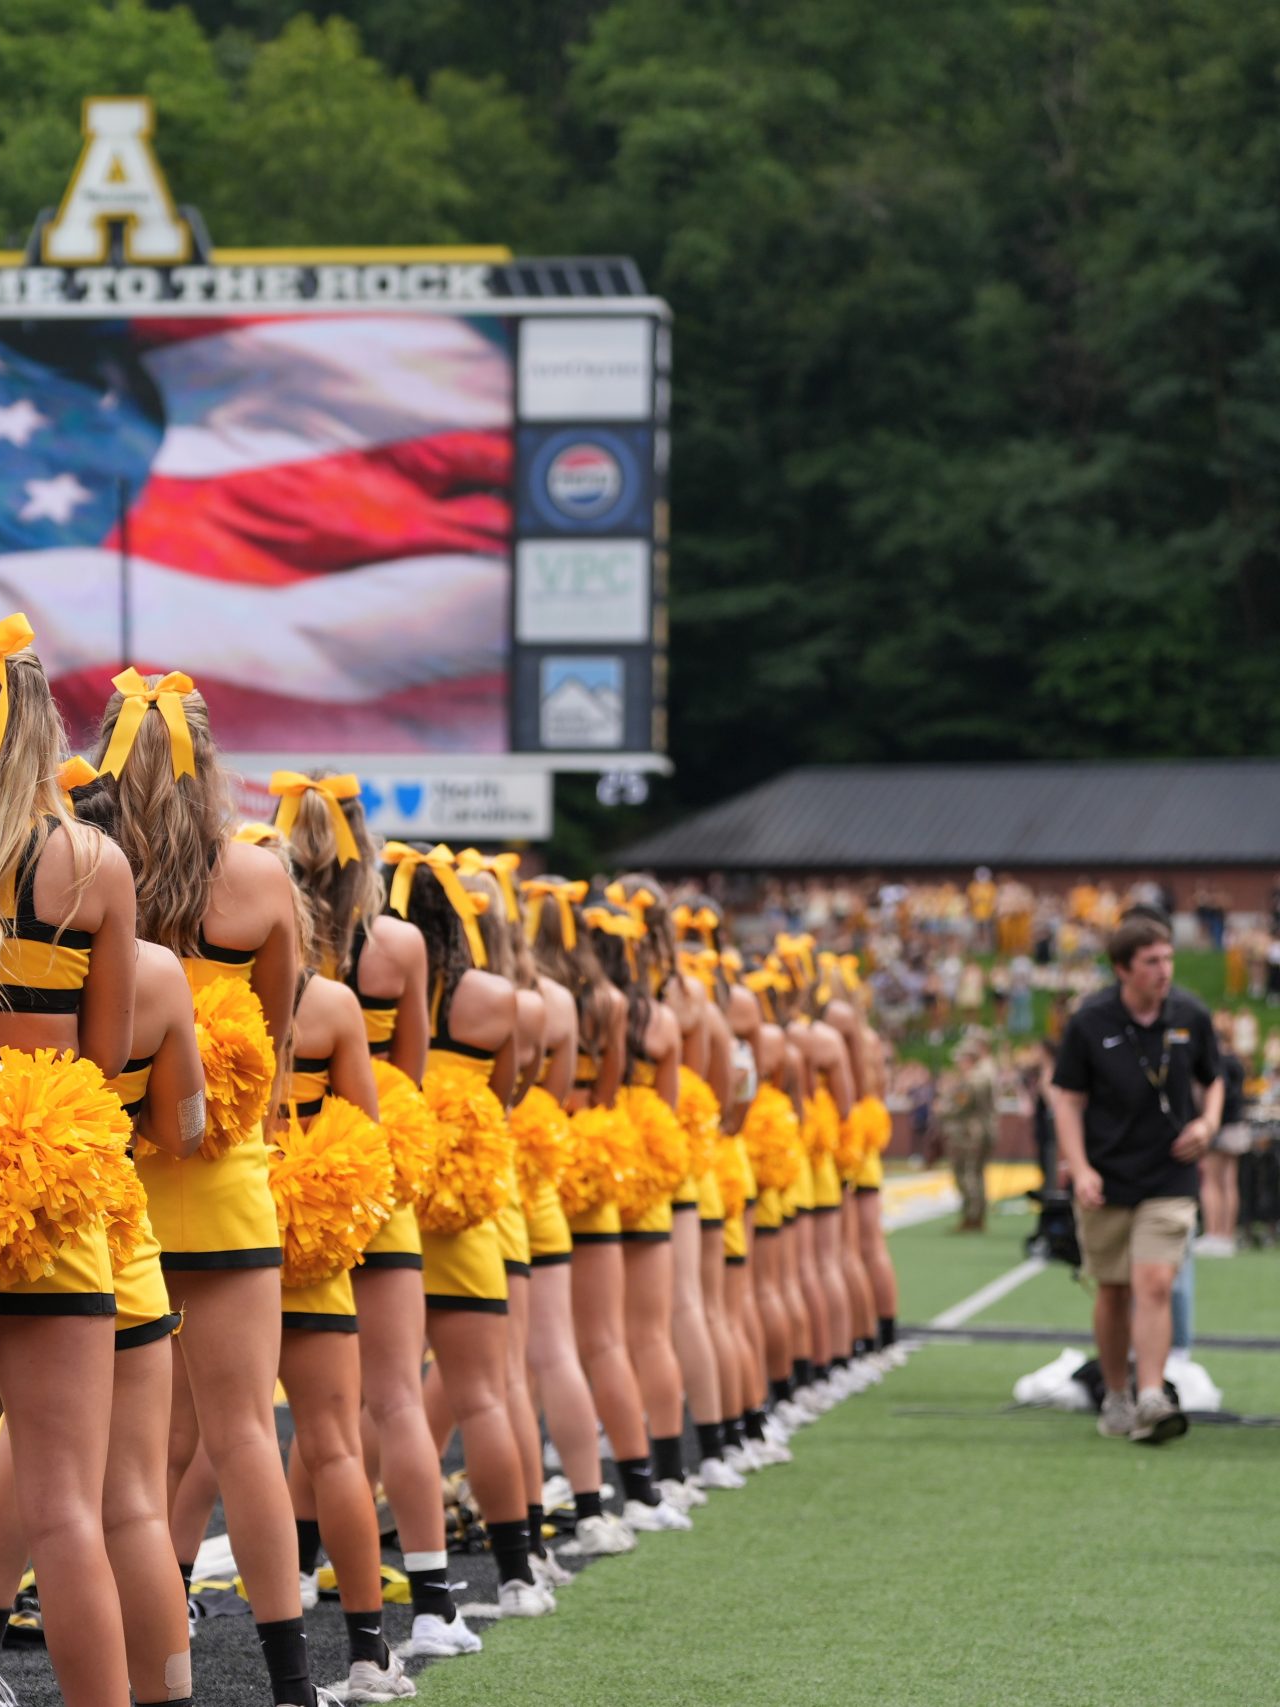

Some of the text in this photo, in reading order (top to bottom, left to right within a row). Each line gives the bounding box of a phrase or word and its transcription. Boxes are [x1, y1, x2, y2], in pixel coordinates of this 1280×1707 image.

[42, 95, 192, 265] A
[76, 267, 159, 303] TO
[172, 265, 302, 302] THE
[319, 264, 490, 301] ROCK
[535, 551, 635, 594] VPC
